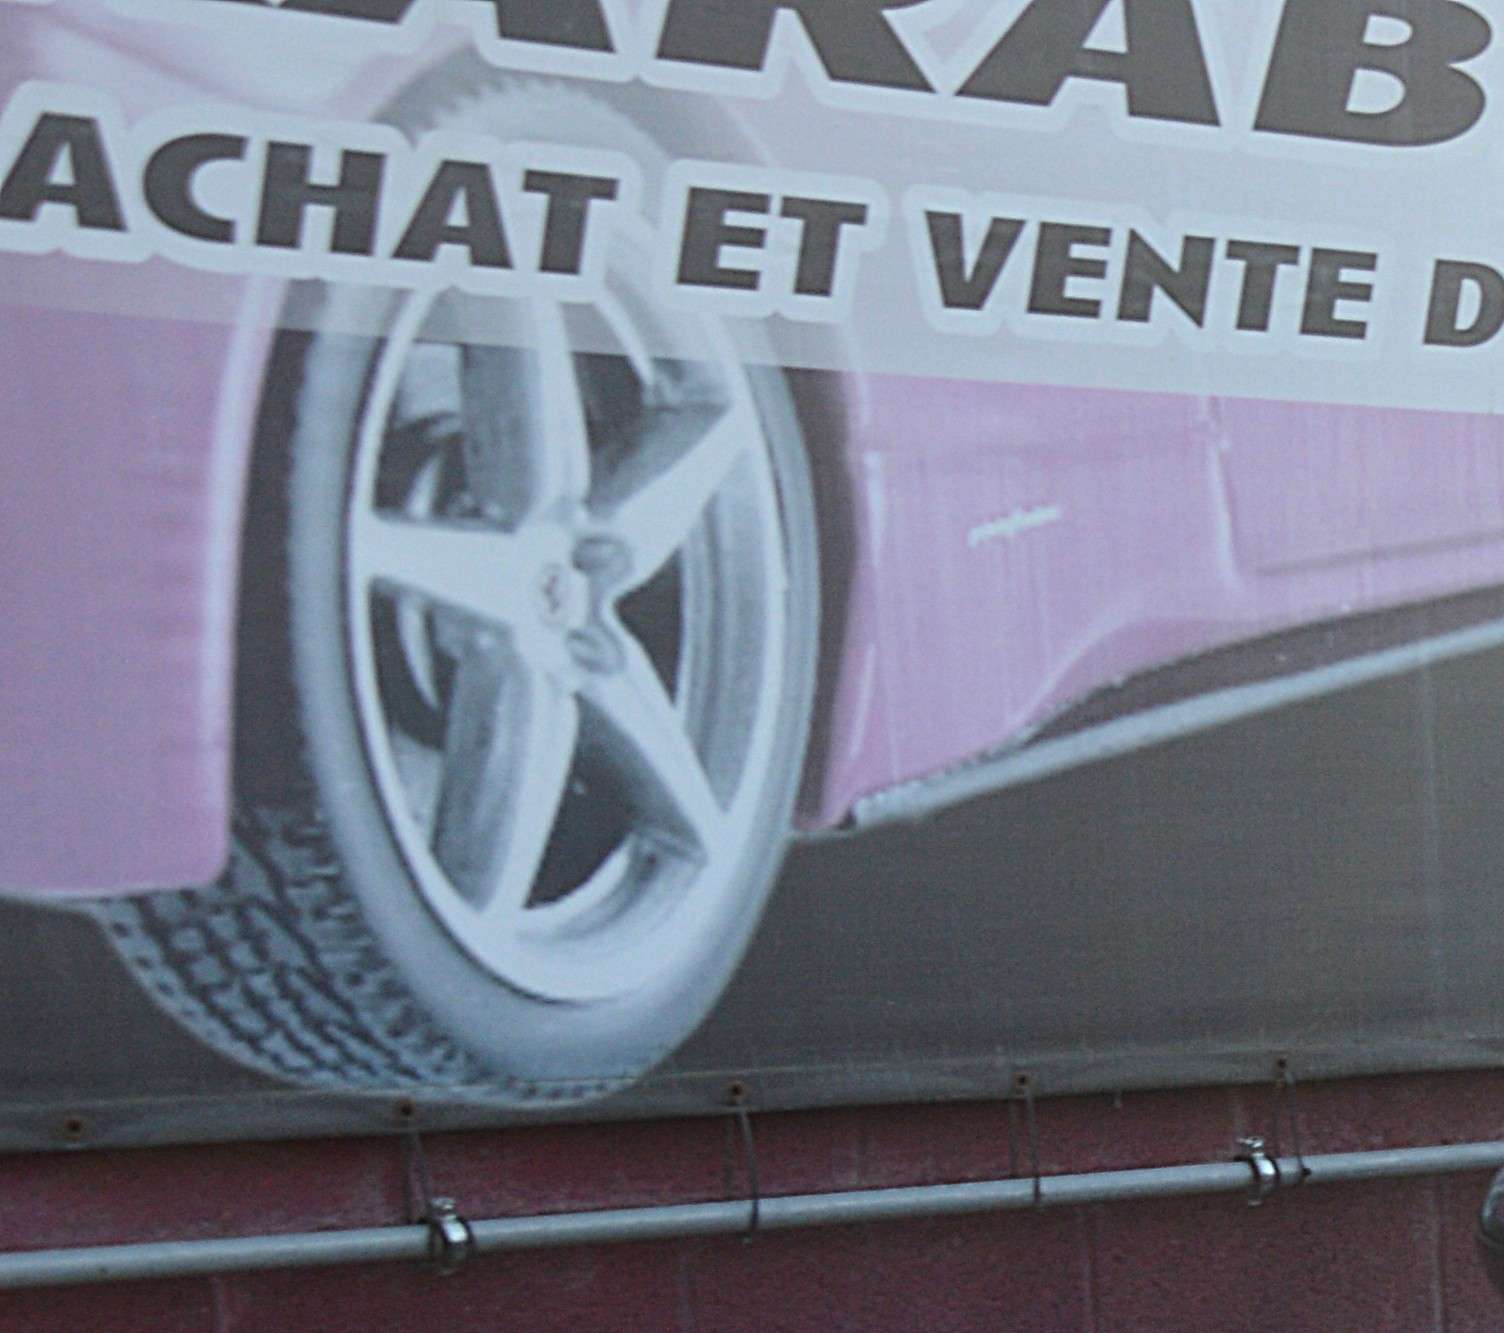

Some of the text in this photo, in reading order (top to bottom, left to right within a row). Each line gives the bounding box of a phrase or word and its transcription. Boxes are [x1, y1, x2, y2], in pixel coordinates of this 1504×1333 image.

[0, 112, 618, 276] ACHAT
[676, 187, 868, 298] ET
[924, 210, 1378, 340] VENTE
